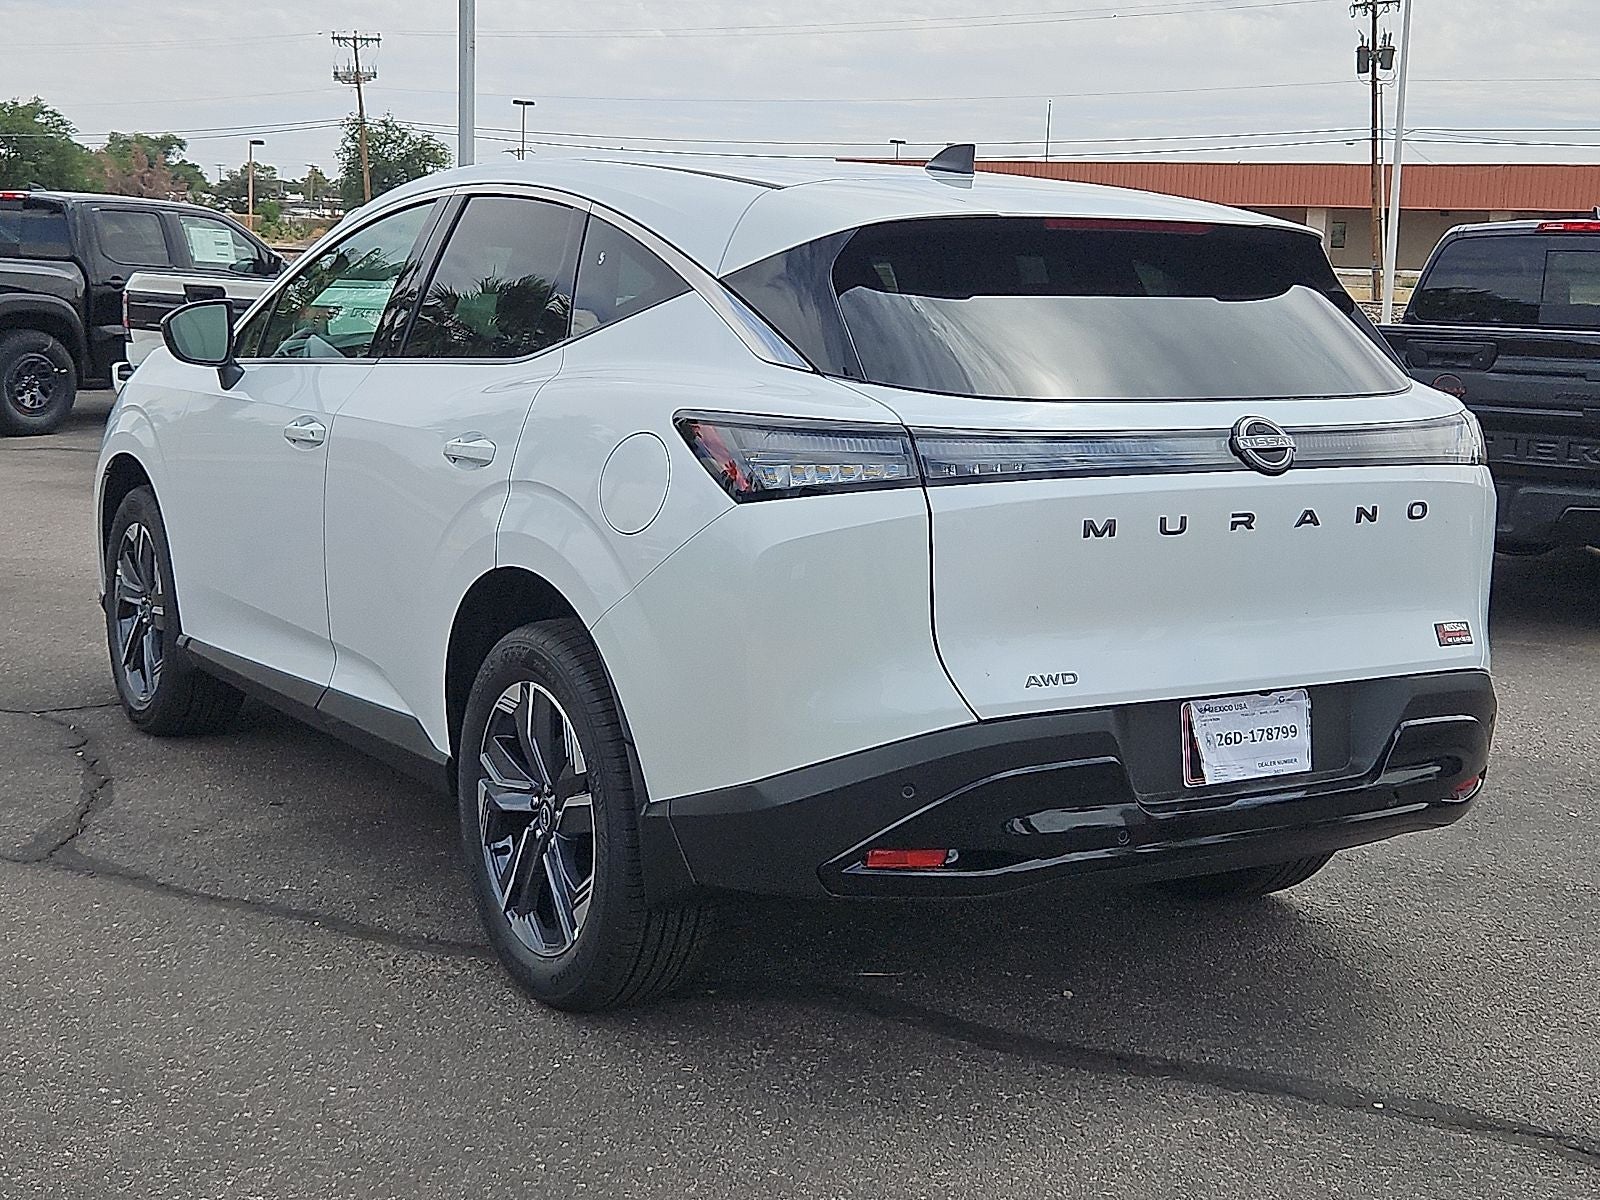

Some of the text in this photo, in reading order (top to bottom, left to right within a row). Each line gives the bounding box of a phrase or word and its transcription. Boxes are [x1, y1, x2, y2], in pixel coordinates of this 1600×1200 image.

[1238, 437, 1296, 449] NISSAN
[1082, 501, 1428, 538] MURANO
[1025, 672, 1078, 688] AWD
[1234, 702, 1248, 711] USA
[1215, 725, 1298, 747] 26D-178799
